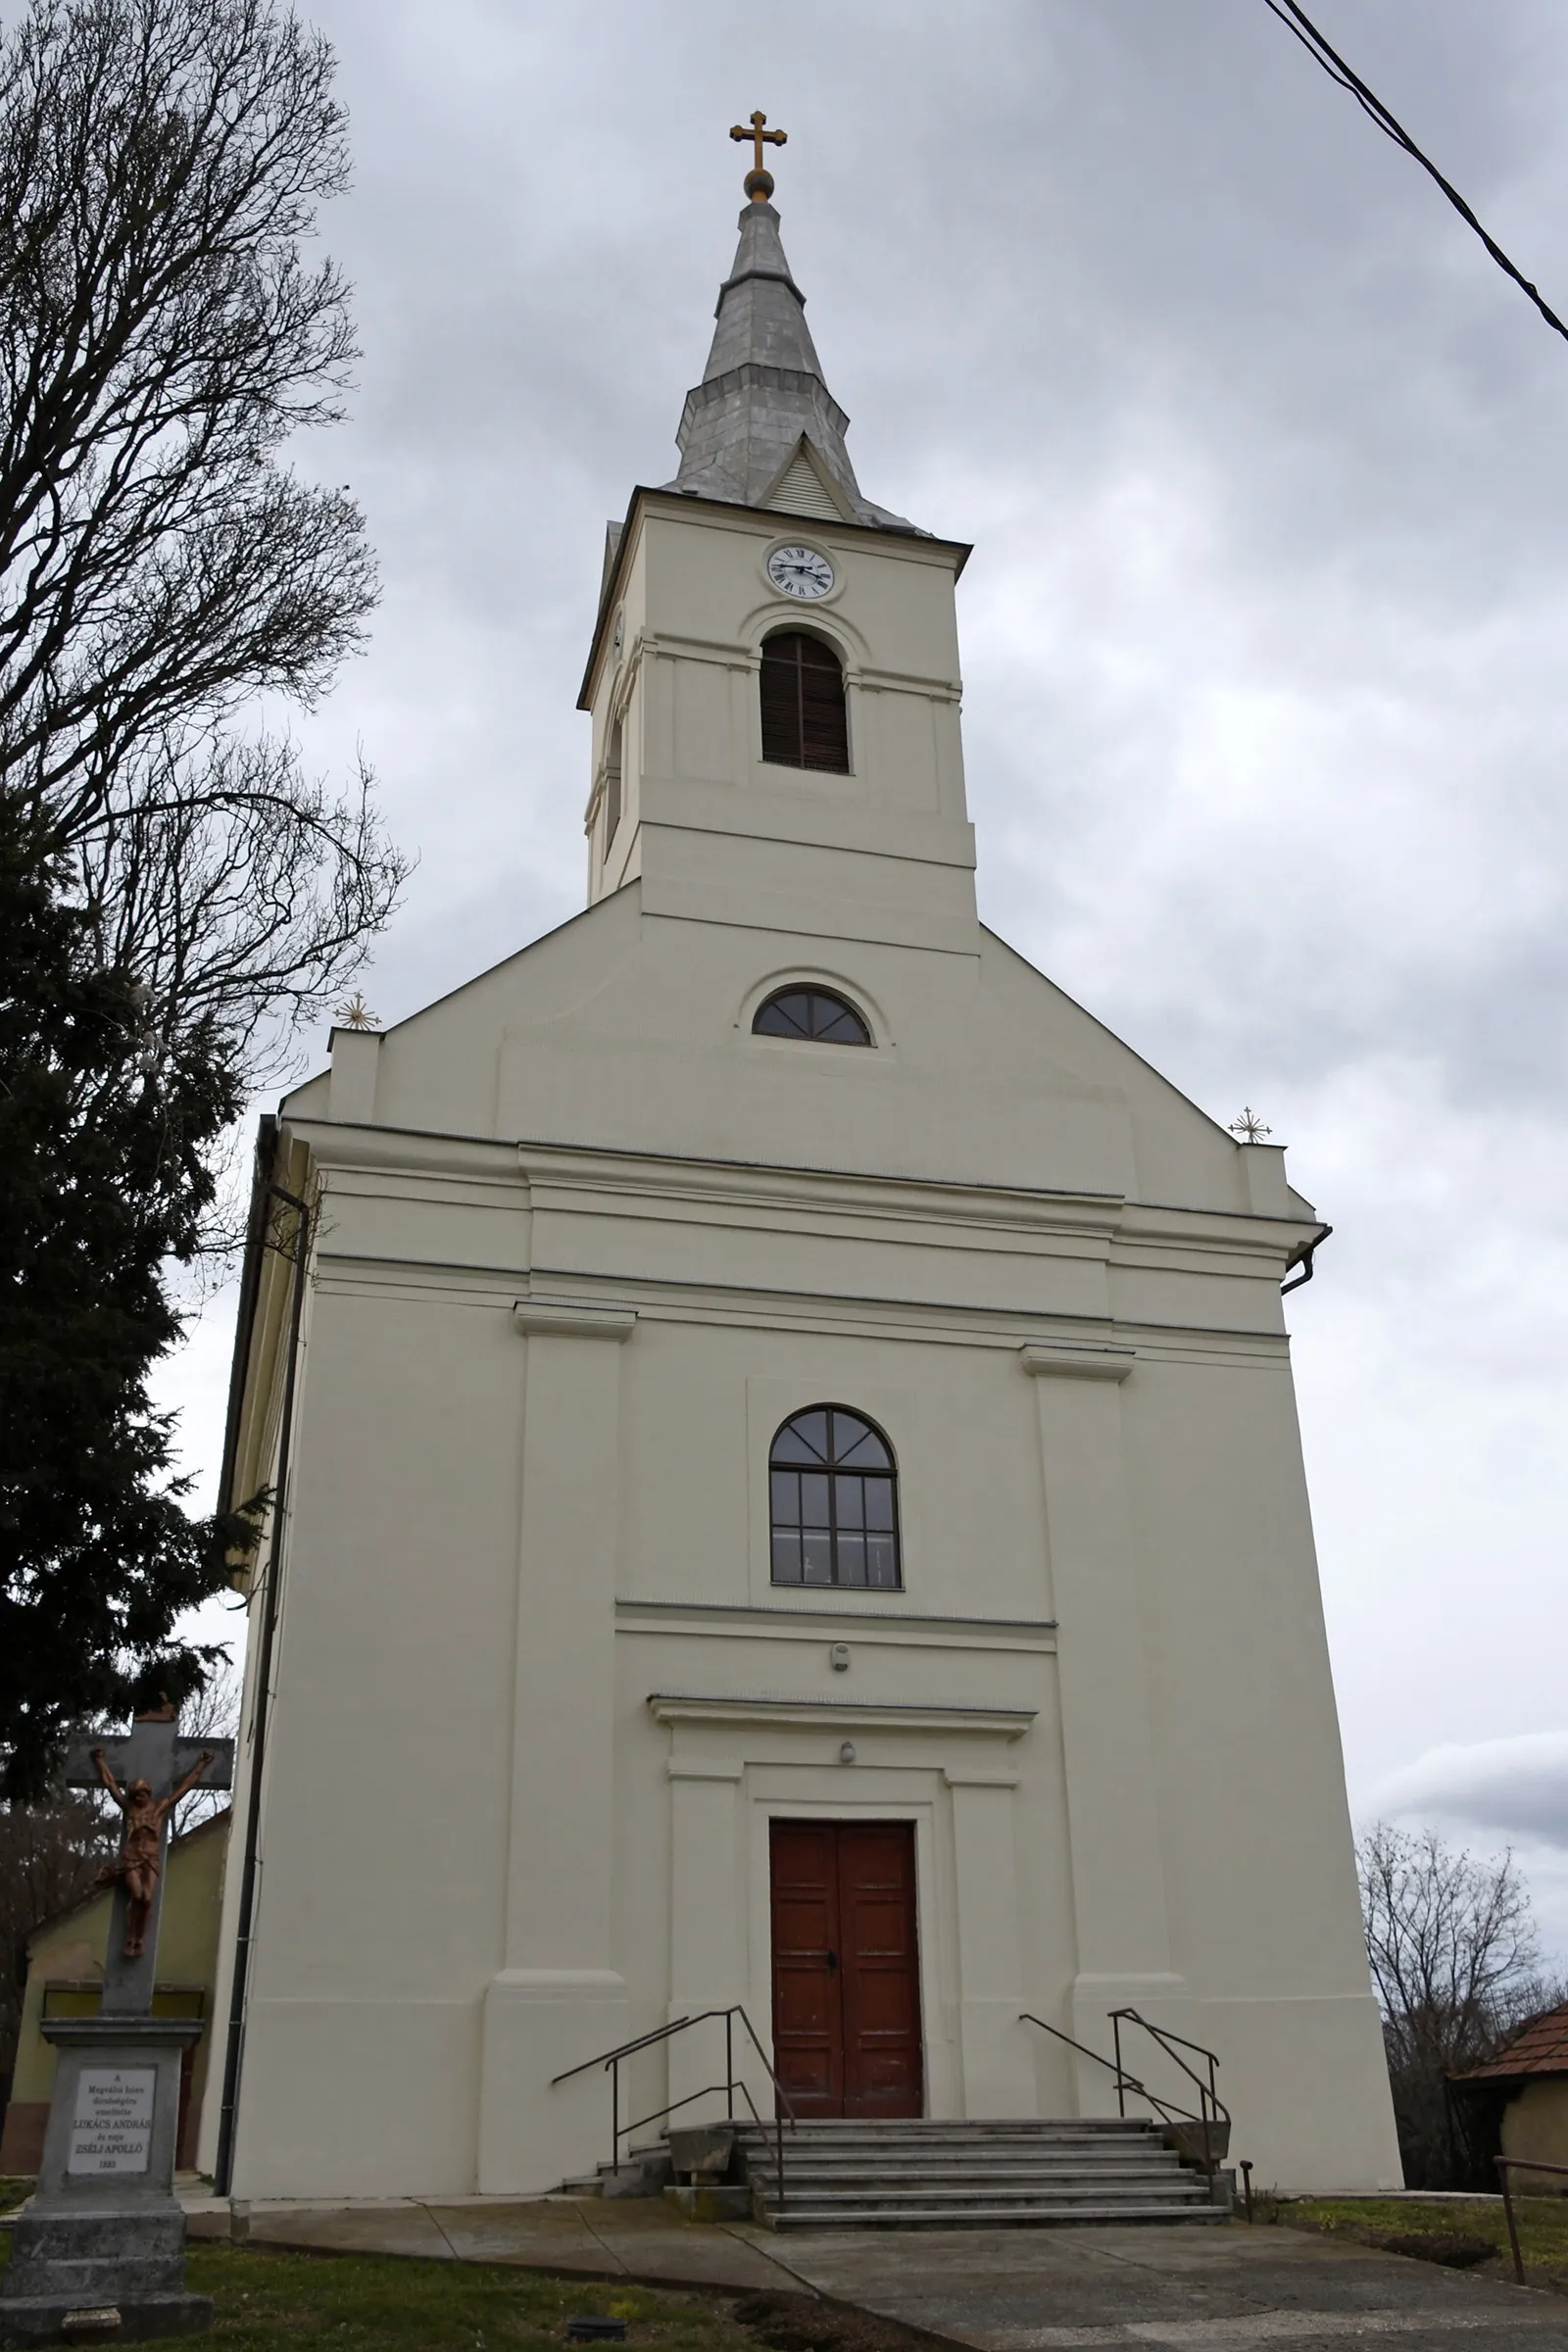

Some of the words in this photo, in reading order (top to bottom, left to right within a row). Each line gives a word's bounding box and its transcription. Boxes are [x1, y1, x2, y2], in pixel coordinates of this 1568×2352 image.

[114, 2074, 121, 2082] A
[73, 2118, 111, 2130] LUKÁCS
[112, 2118, 152, 2130] ANDRÁS
[75, 2142, 104, 2154] ZSÉLI
[105, 2141, 143, 2154] APOLLÓ
